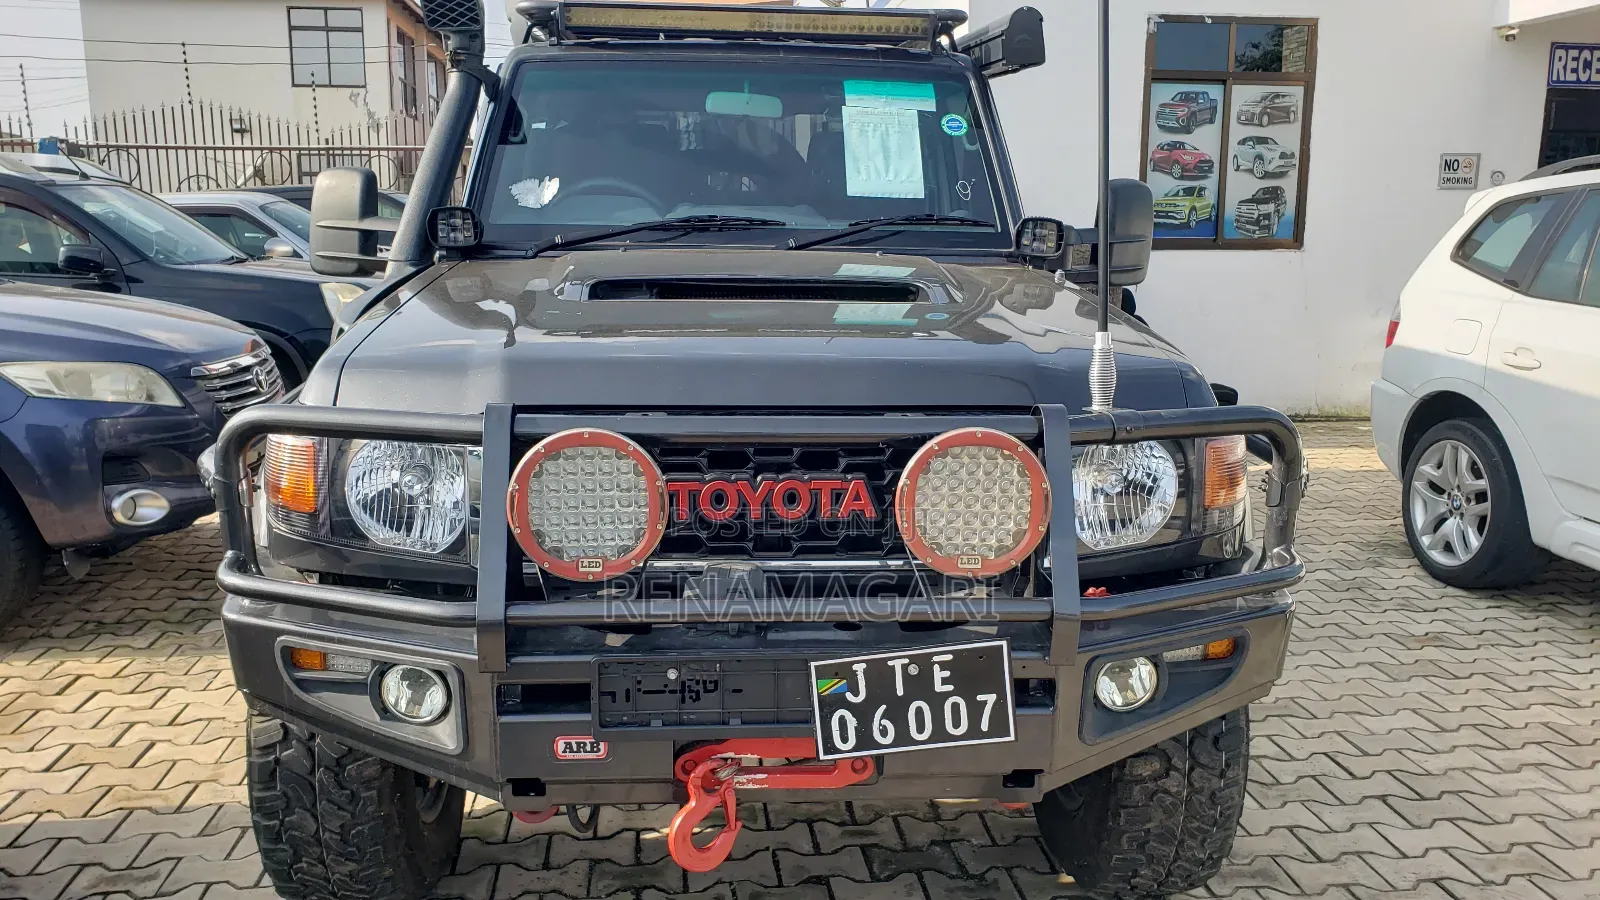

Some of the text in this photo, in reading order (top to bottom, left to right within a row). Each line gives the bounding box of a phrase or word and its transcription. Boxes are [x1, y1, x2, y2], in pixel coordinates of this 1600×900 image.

[1552, 49, 1600, 82] RECE
[1443, 158, 1460, 172] NO
[1441, 176, 1473, 185] SMOKING
[667, 480, 878, 521] TOYOTA
[580, 560, 602, 569] LED
[959, 557, 980, 565] LED
[831, 693, 997, 751] 06007
[561, 741, 601, 754] ARB
